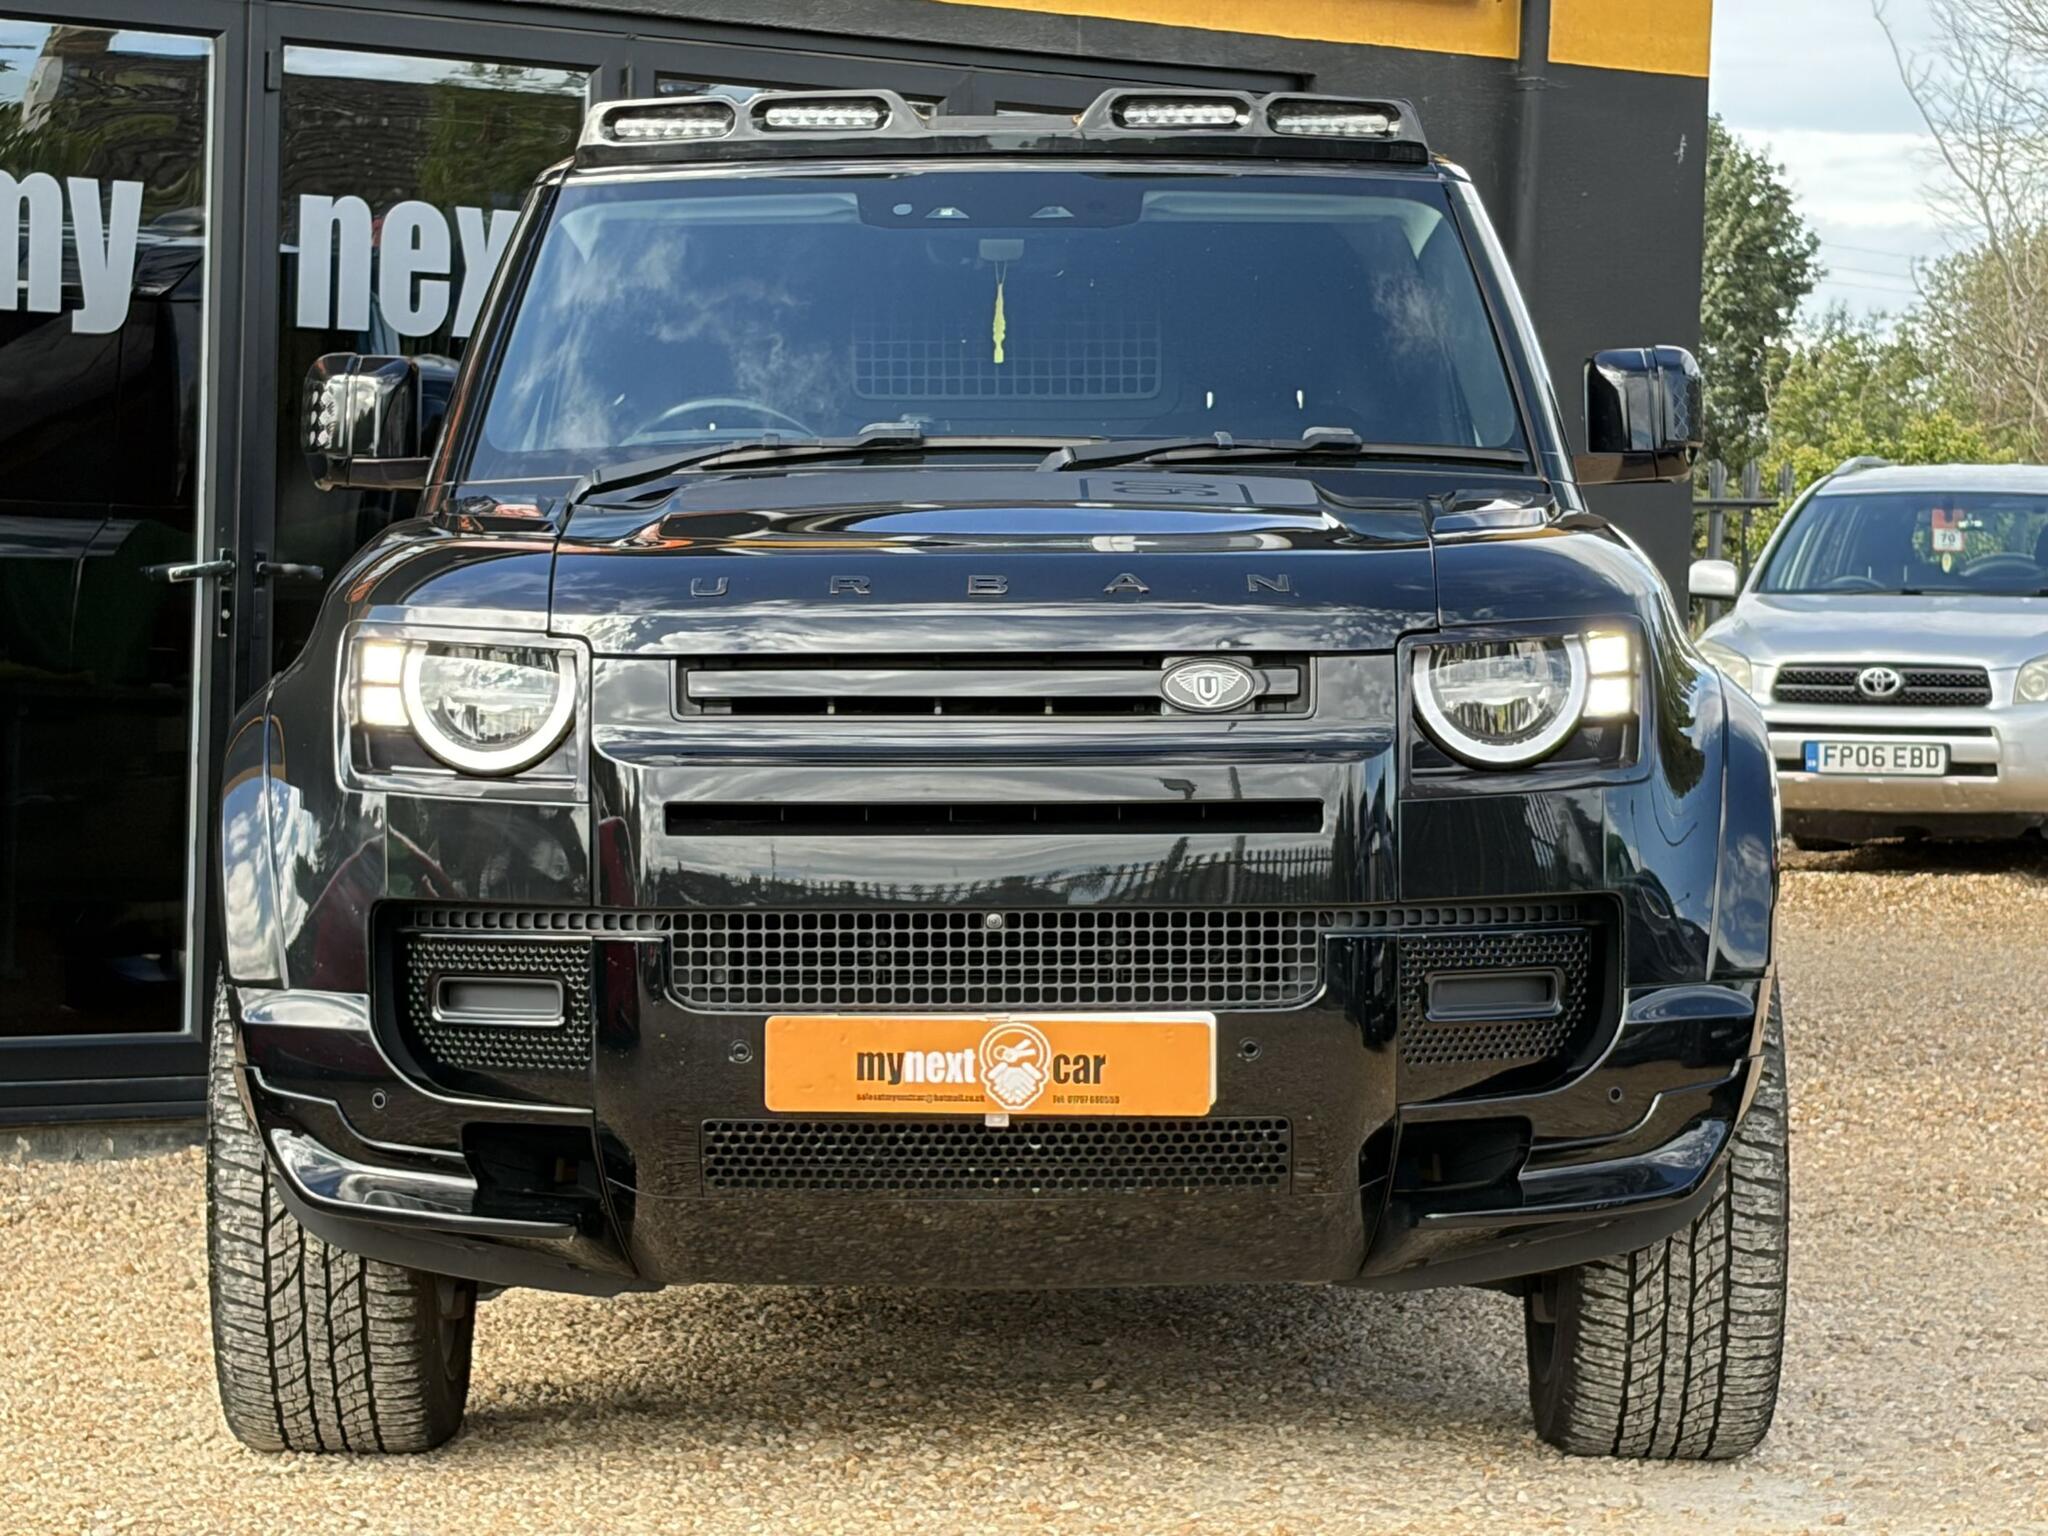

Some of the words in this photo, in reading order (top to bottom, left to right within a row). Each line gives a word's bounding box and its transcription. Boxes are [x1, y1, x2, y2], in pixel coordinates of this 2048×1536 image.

[0, 170, 144, 334] my
[691, 573, 1291, 597] URBAN
[1823, 745, 1886, 768] FP06
[1893, 747, 1939, 768] EBD
[1053, 1054, 1106, 1084] car
